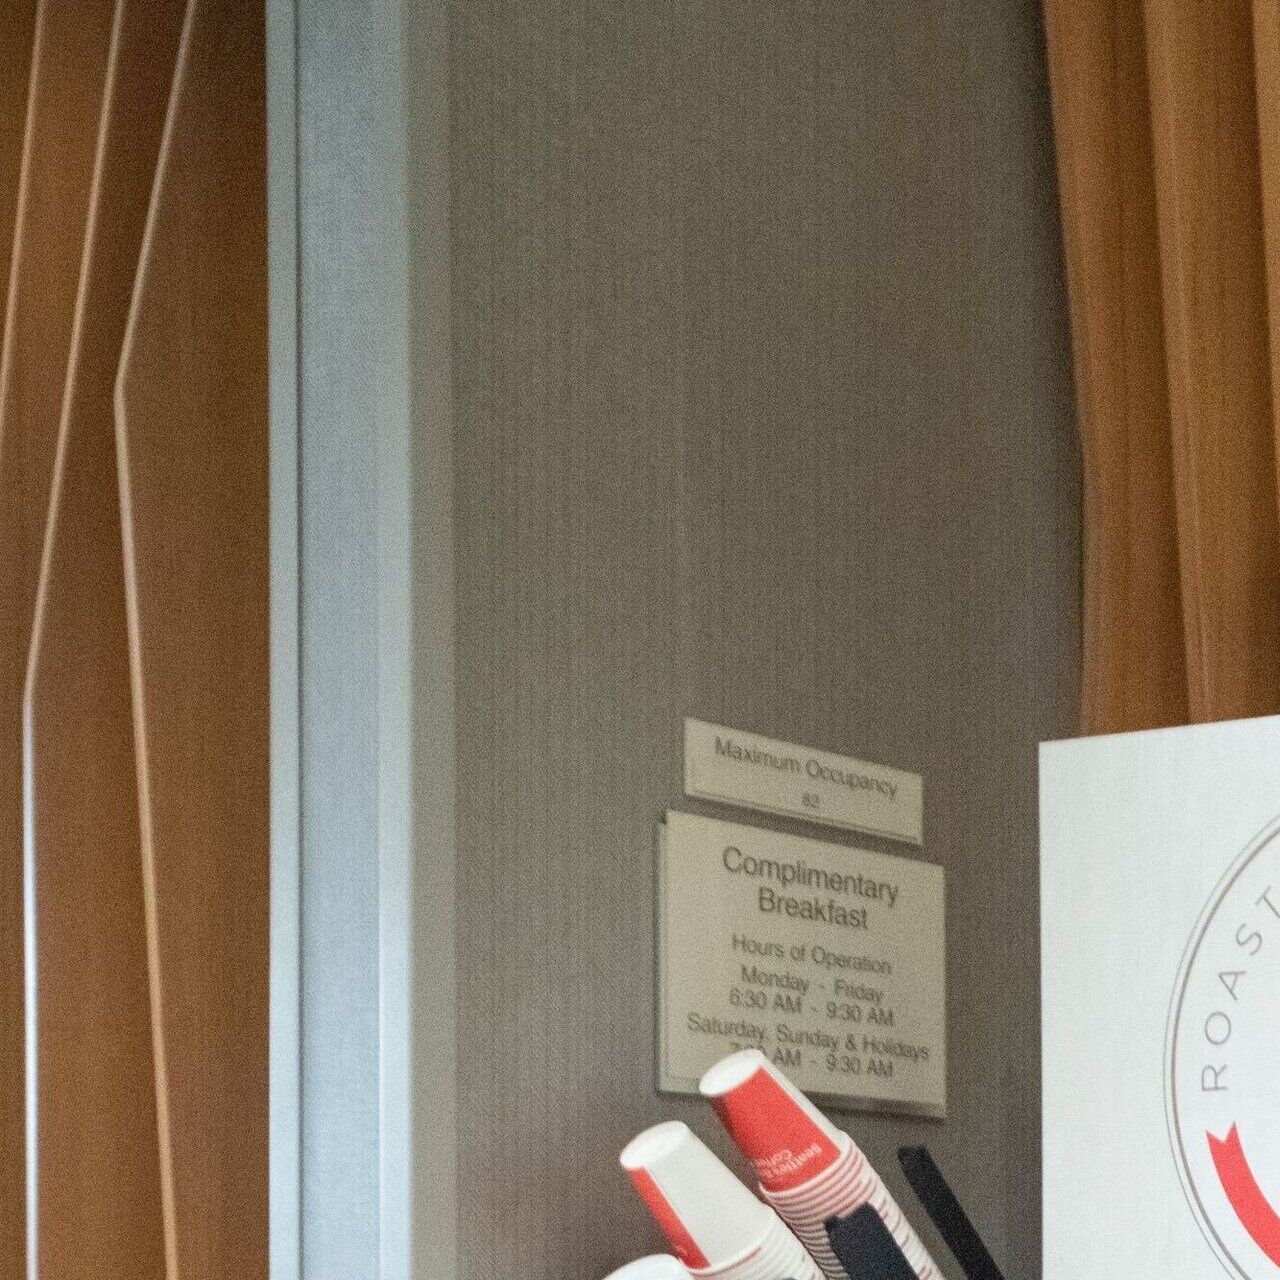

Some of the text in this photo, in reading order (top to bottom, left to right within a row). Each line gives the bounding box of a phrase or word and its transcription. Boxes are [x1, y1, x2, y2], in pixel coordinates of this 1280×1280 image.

[715, 737, 899, 801] Maximum Occupancy
[722, 846, 899, 909] Complimentary
[757, 885, 869, 930] Breakfast
[731, 932, 893, 975] Hours of Operation
[740, 963, 809, 997] Monday
[834, 978, 886, 1005] Friday
[729, 986, 768, 1010] 6:30
[772, 993, 803, 1014] AM
[826, 1000, 863, 1024] 9:30
[866, 1006, 895, 1027] AM
[772, 1048, 802, 1067] AM
[866, 1059, 894, 1079] AM
[776, 1022, 839, 1050] Sunday
[862, 1034, 930, 1064] Holidays
